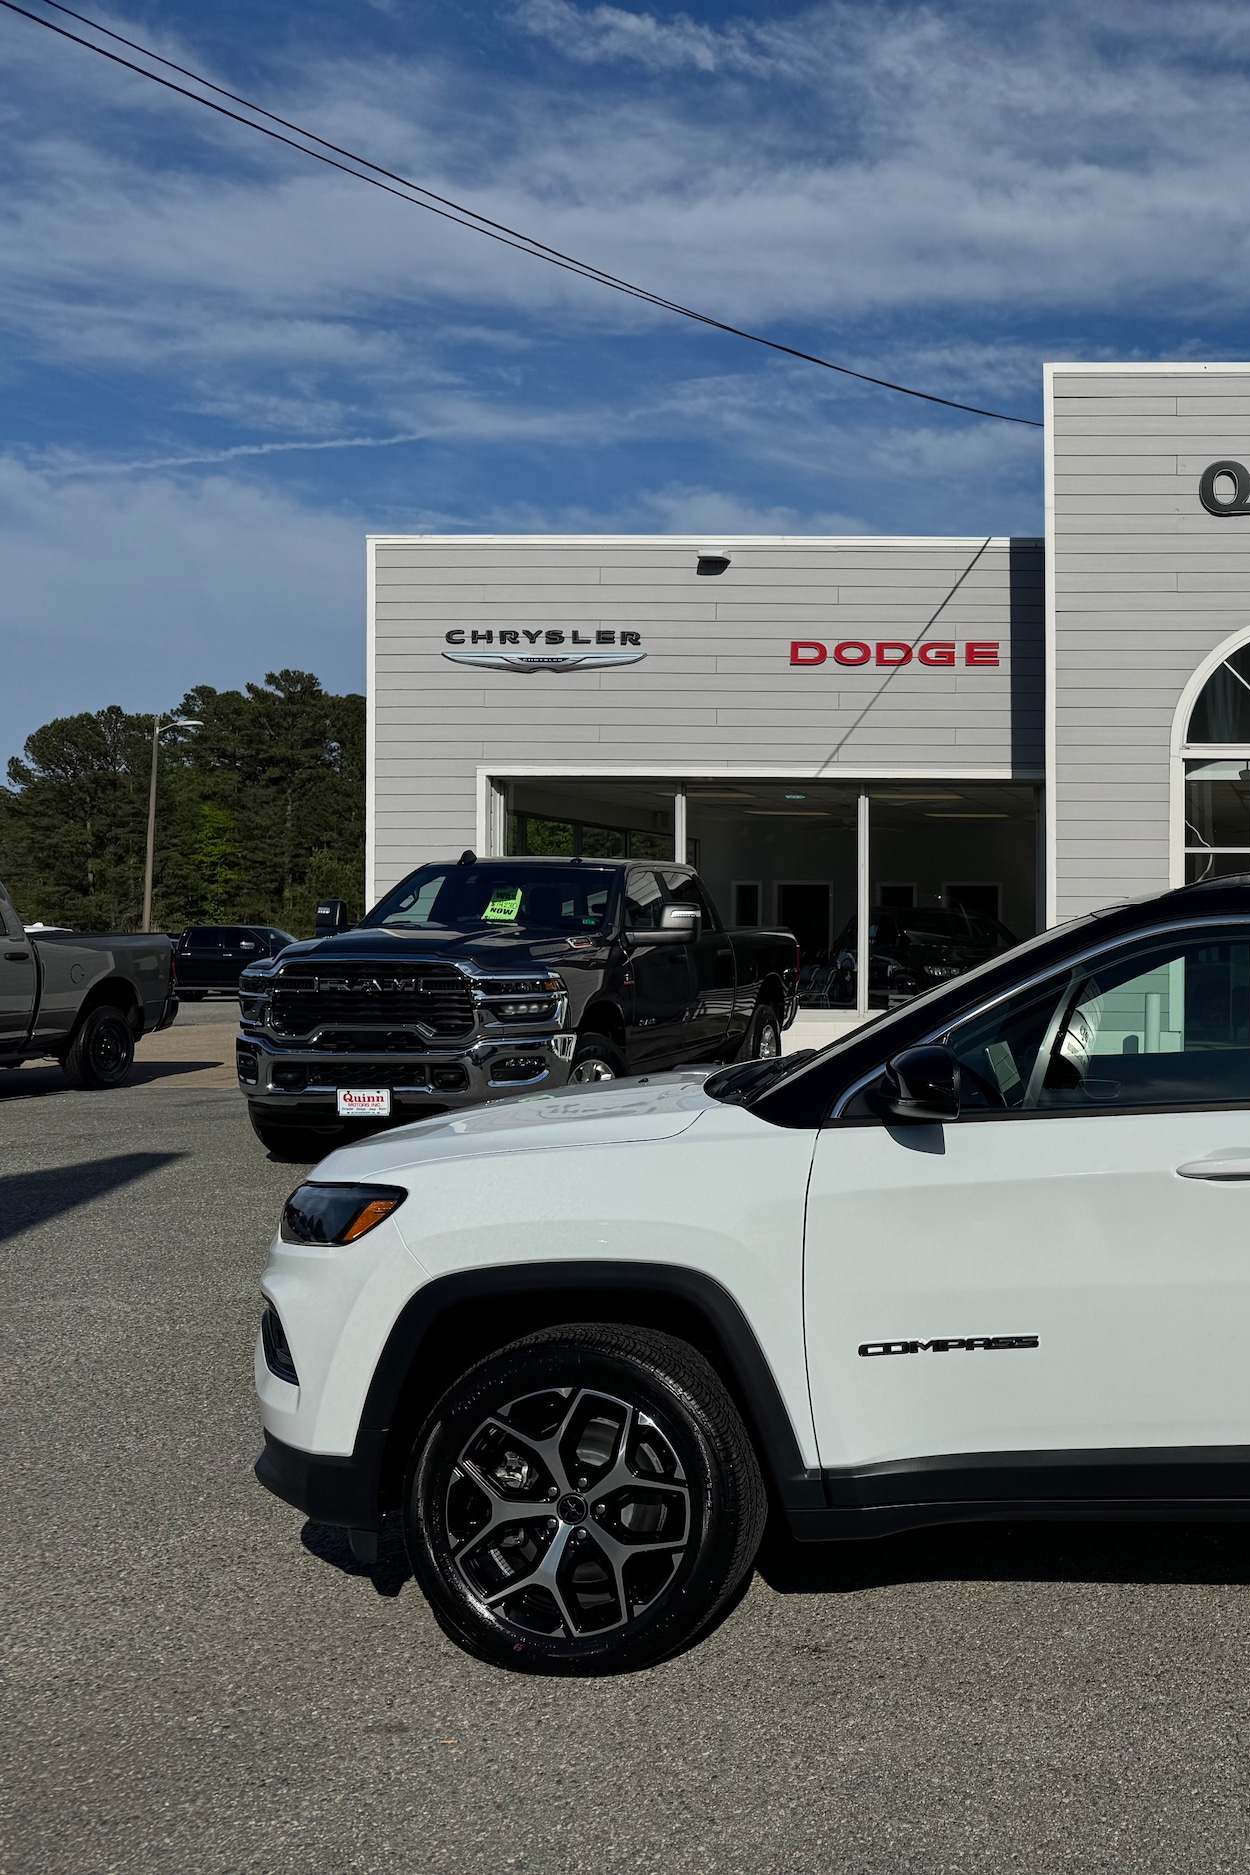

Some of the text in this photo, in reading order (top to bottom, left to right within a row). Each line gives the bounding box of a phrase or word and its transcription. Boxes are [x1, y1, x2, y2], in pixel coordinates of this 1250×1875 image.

[445, 629, 642, 646] CHRYSLER
[789, 641, 1000, 667] DODGE
[490, 907, 514, 915] NOW
[319, 978, 416, 992] RAM
[343, 1093, 385, 1103] Quinn
[858, 1335, 1040, 1357] COMPASS
